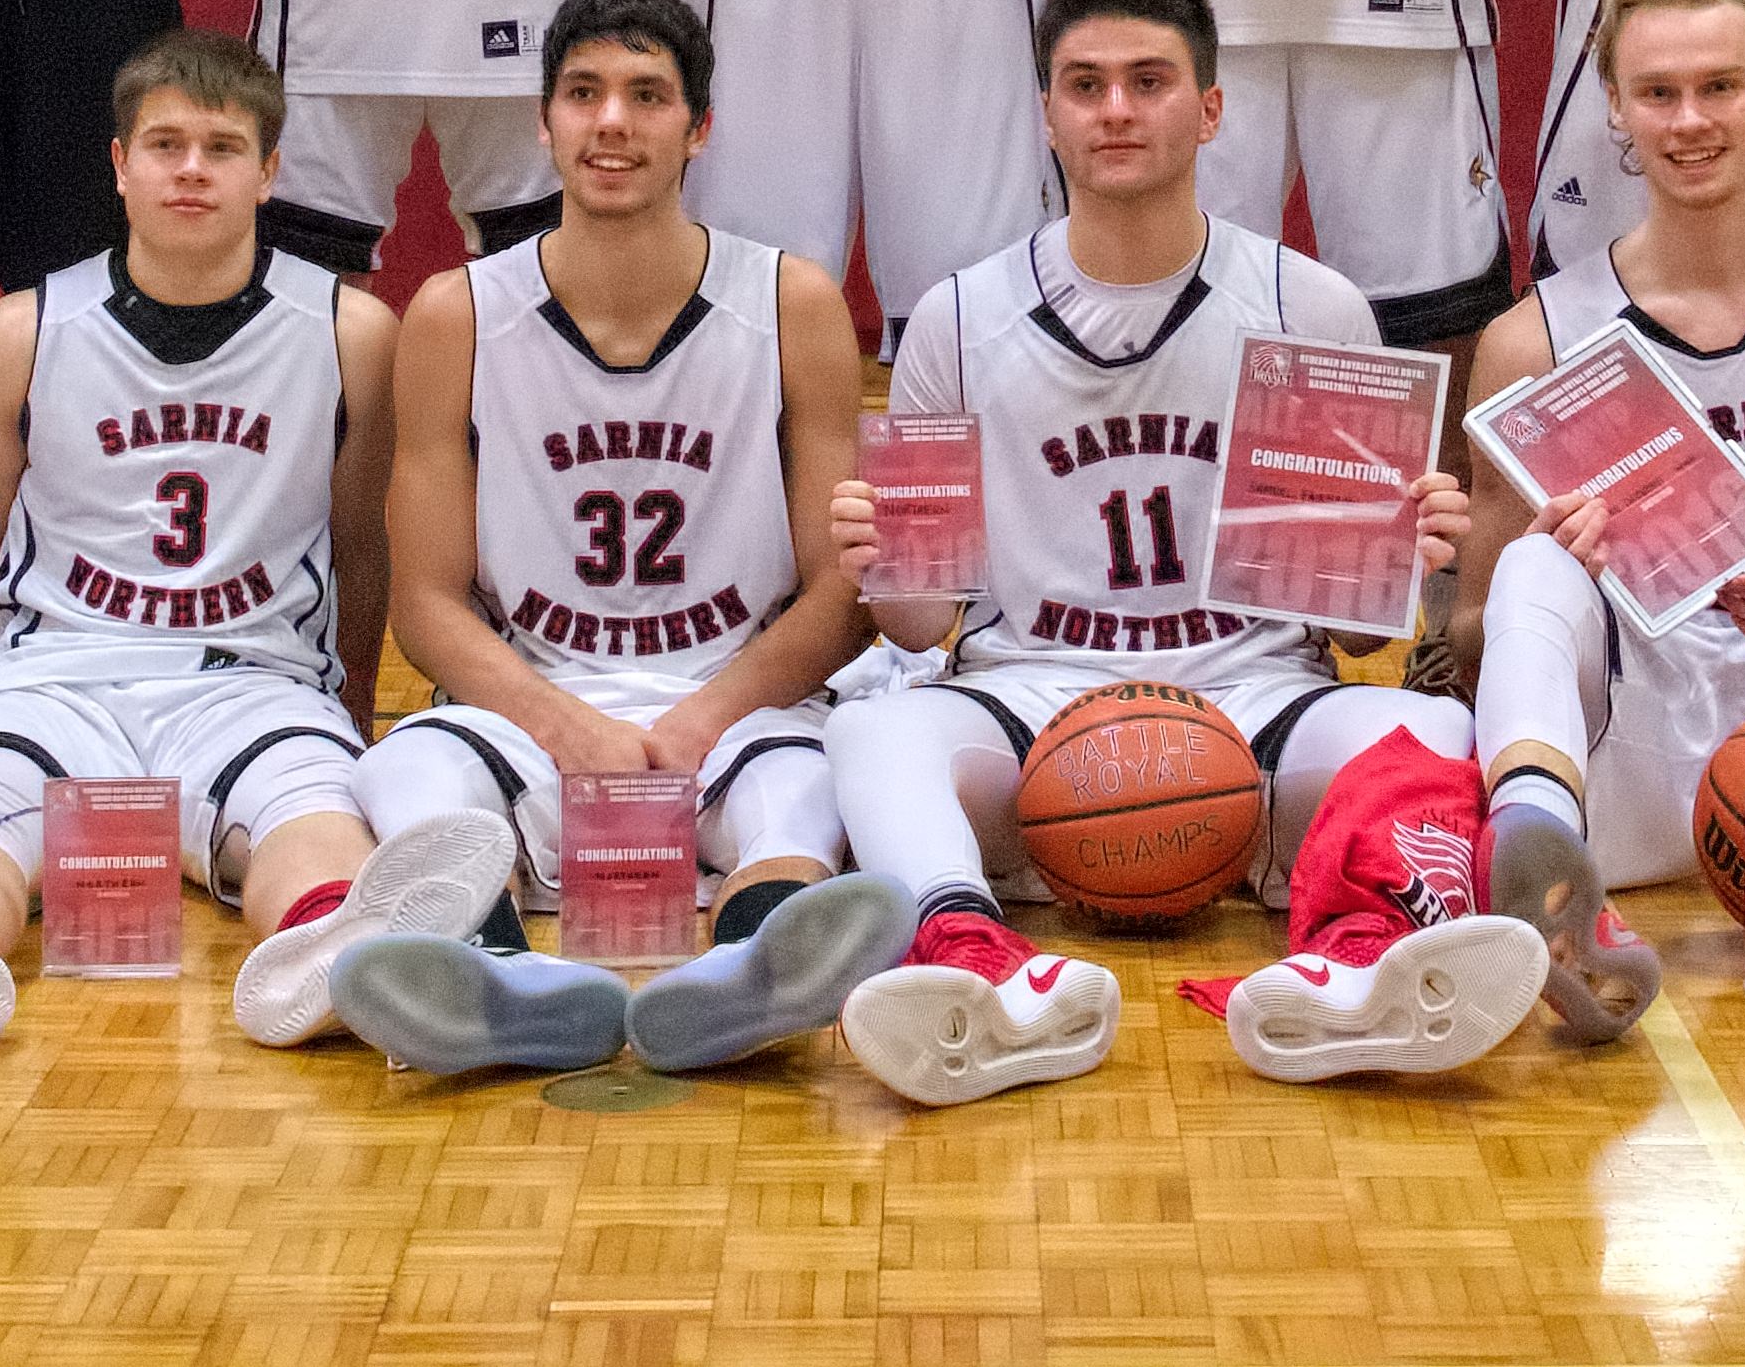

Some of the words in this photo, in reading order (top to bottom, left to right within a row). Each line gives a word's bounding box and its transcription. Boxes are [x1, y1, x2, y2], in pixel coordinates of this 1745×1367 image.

[1552, 192, 1587, 207] adidas
[96, 403, 272, 456] SARNIA
[543, 421, 713, 473] SARNIA
[1041, 414, 1218, 477] SARNIA
[1251, 448, 1402, 485] CONGRATULATIONS
[1579, 426, 1684, 499] ONGRATULATIONS
[873, 484, 971, 499] CONGRATULATIONS
[153, 472, 208, 567] 3
[574, 490, 685, 587] 32
[1099, 485, 1186, 590] 11
[66, 553, 274, 628] NORTHERN
[511, 584, 751, 656] NORTHERN
[1029, 599, 1261, 652] NORTHER
[1055, 722, 1208, 779] BATTLE
[1071, 751, 1206, 804] ROYAL
[59, 855, 168, 870] CONGRATULATIONS
[576, 847, 683, 863] CONGRATULATIONS
[1078, 814, 1223, 869] CHAMPS
